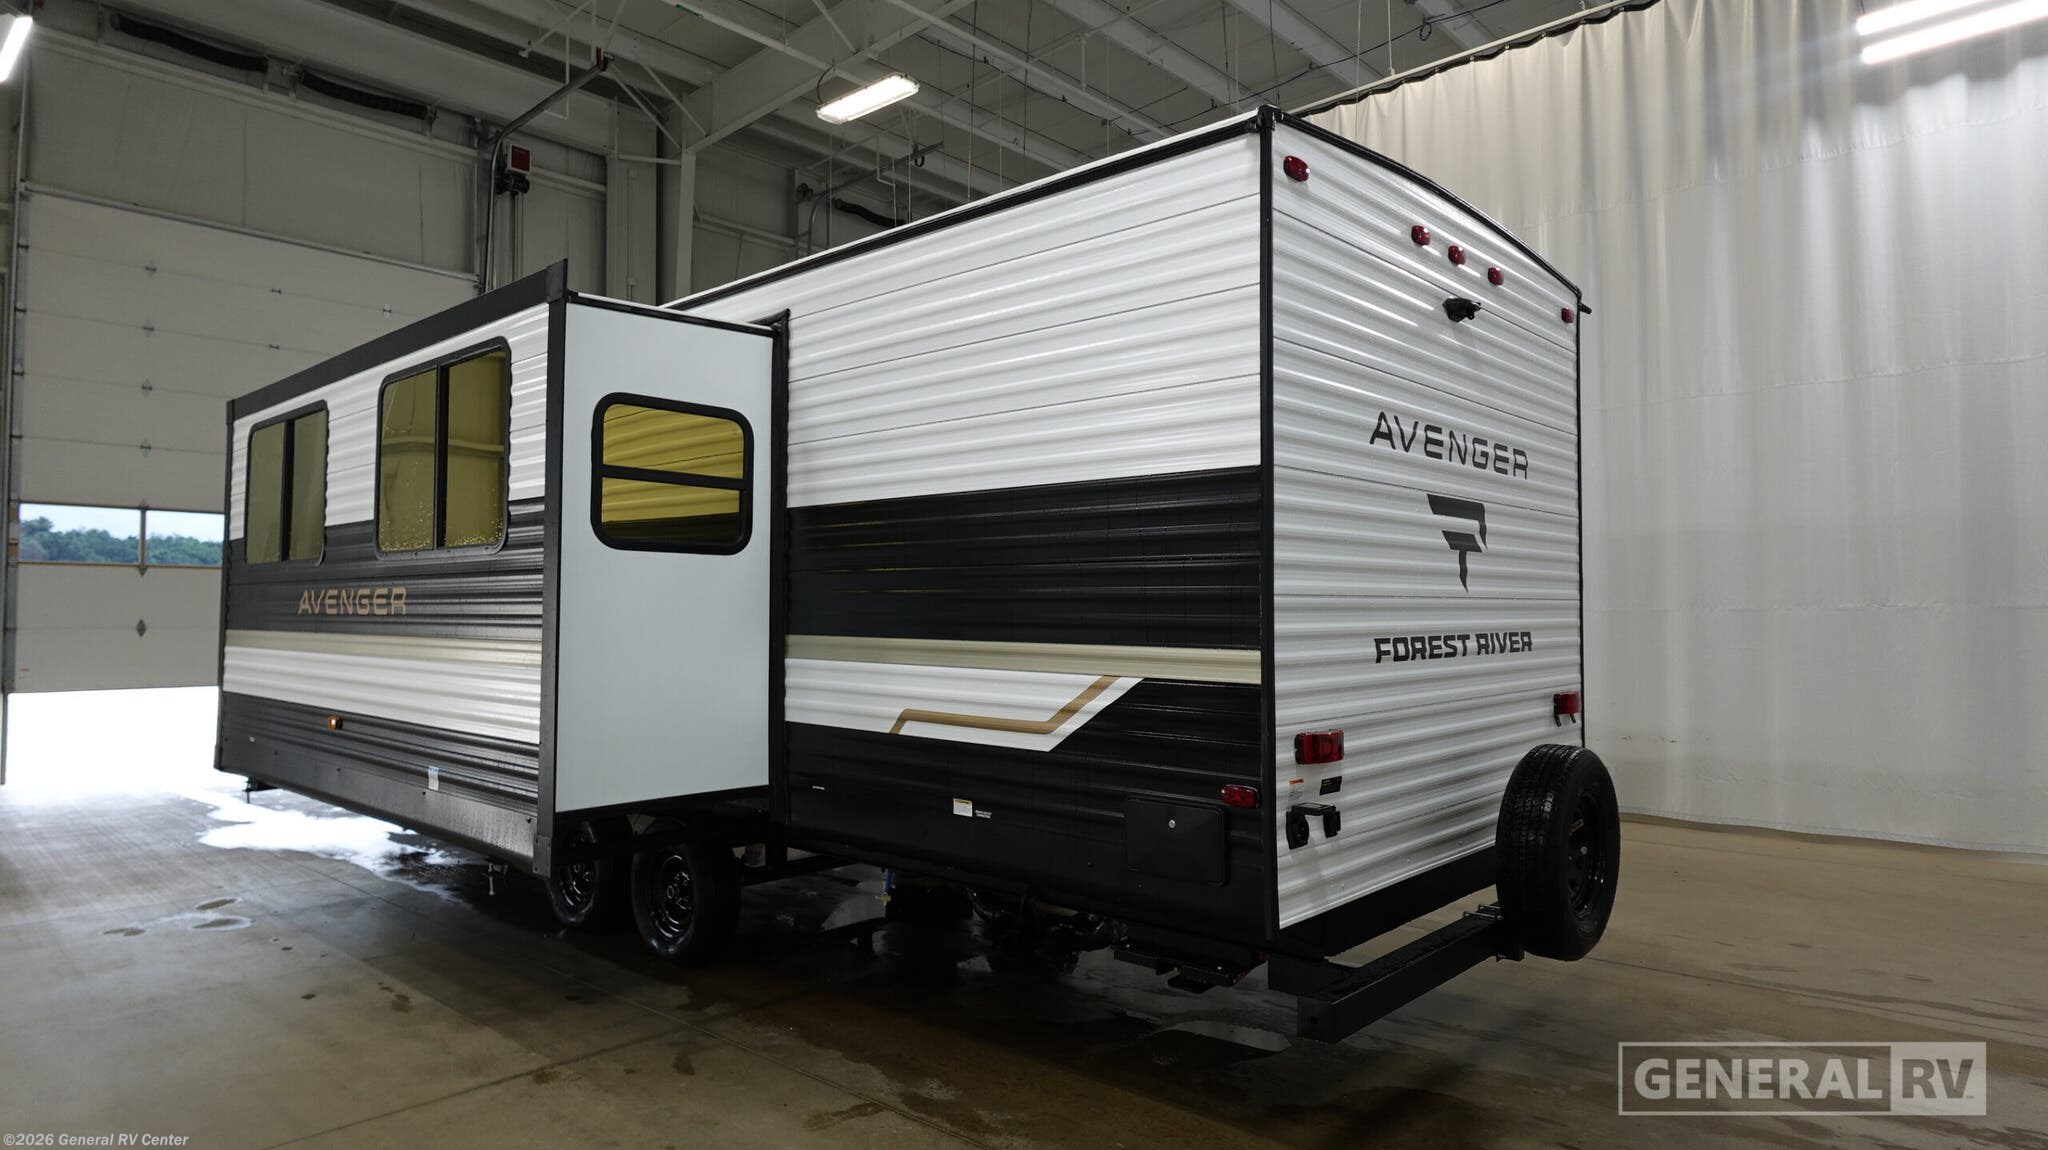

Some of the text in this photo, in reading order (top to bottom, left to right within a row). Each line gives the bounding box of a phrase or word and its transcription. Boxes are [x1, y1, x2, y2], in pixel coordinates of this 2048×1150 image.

[1369, 411, 1528, 479] AVENGER
[298, 586, 407, 616] AVENGER
[1373, 632, 1533, 664] FOREST RIVER
